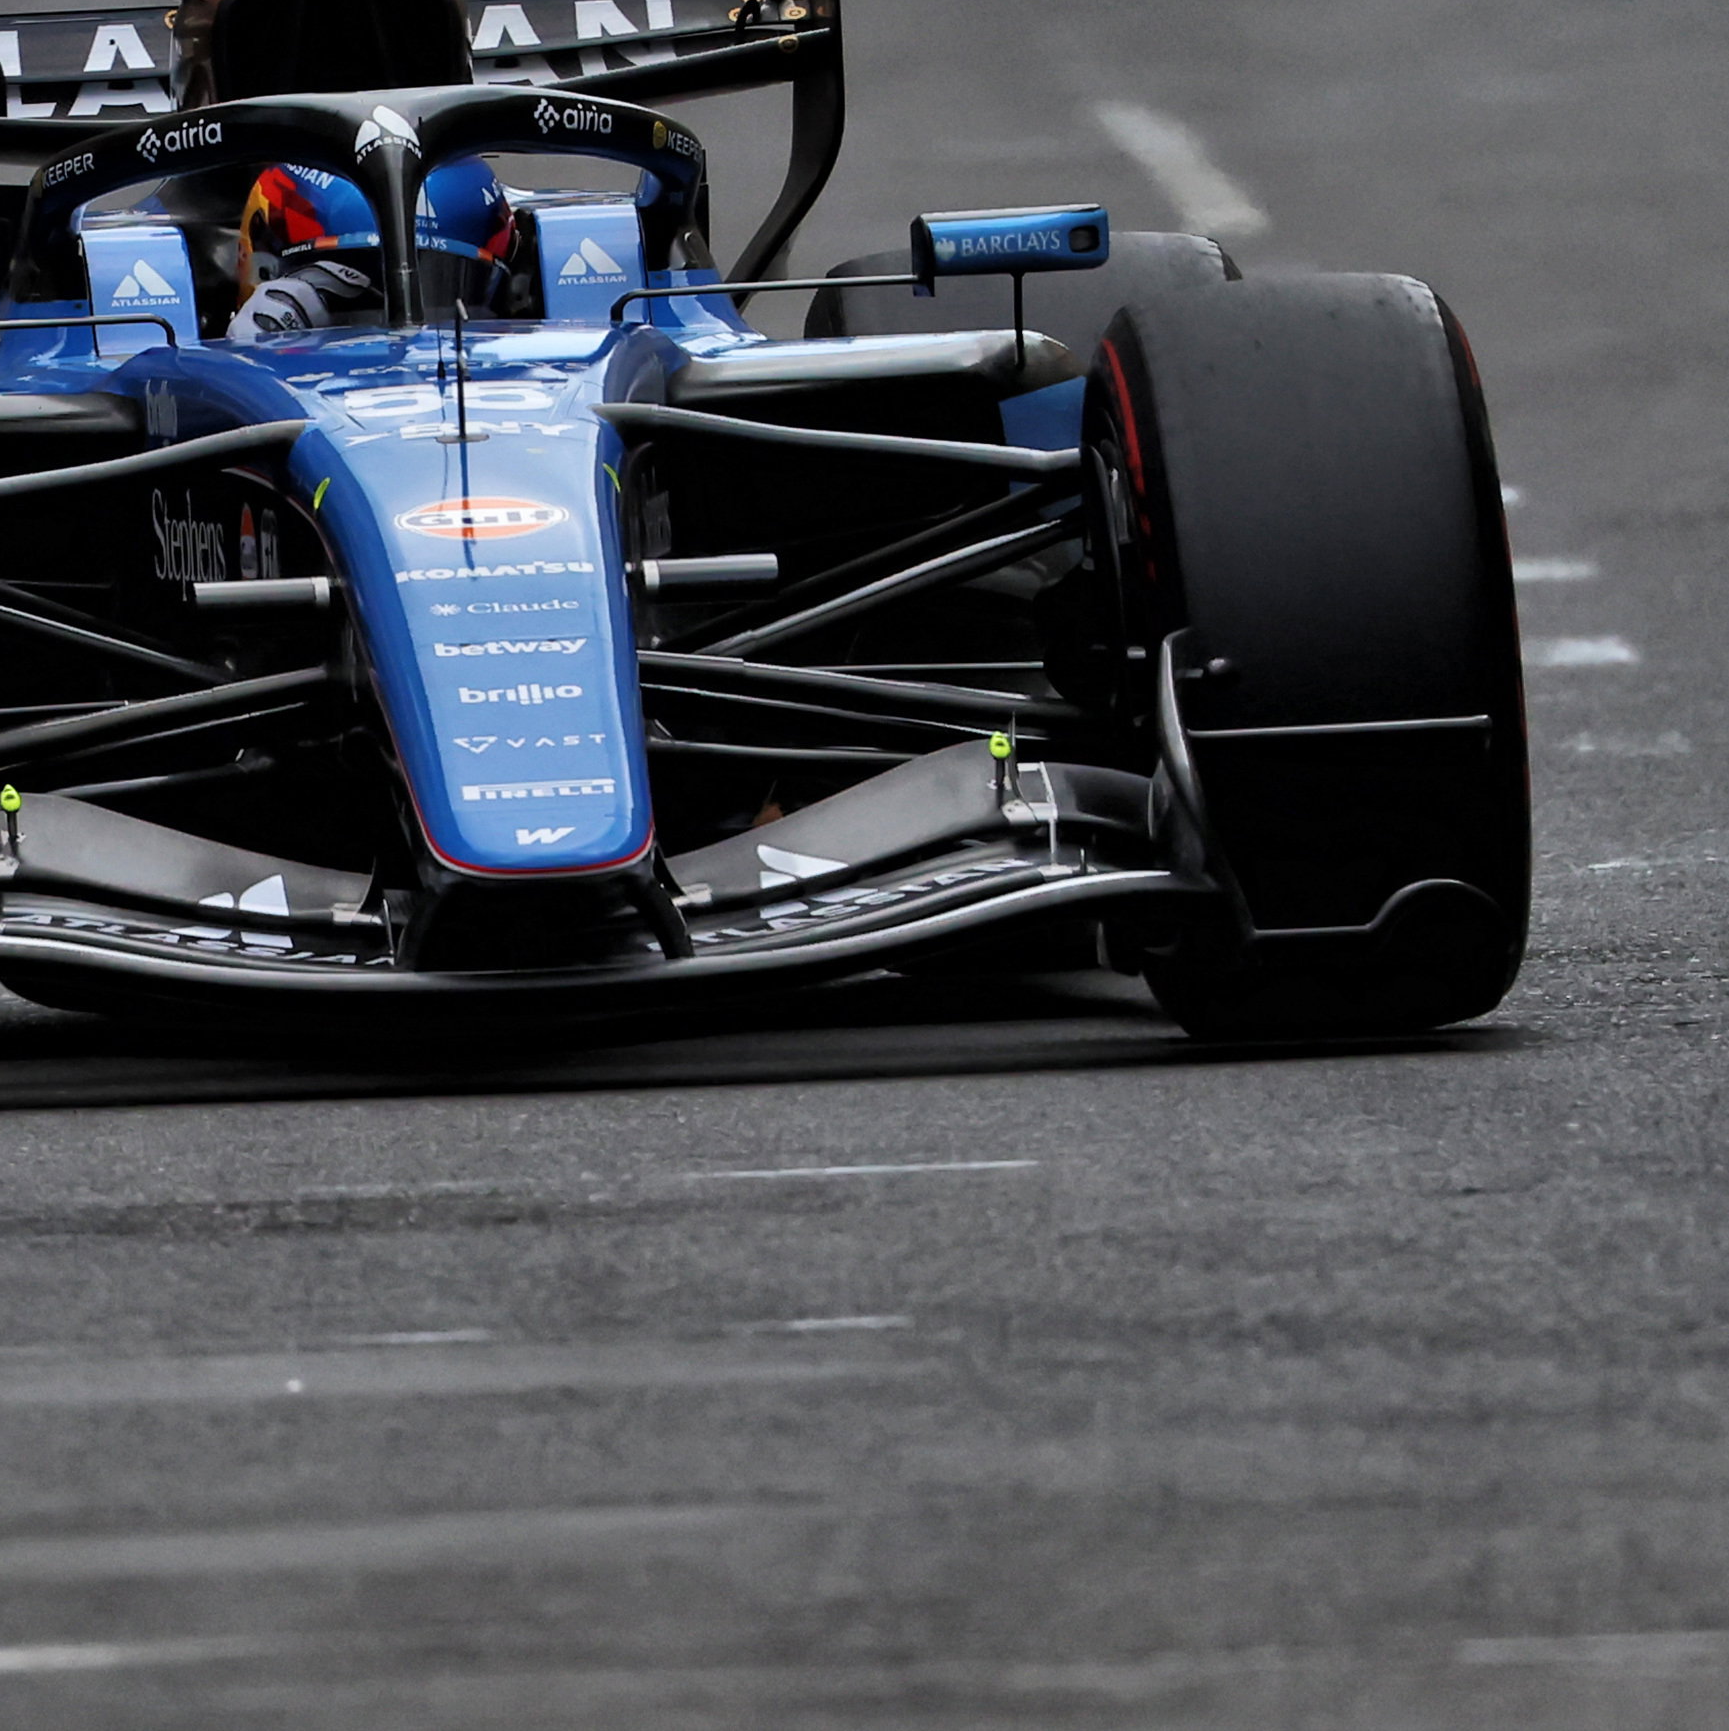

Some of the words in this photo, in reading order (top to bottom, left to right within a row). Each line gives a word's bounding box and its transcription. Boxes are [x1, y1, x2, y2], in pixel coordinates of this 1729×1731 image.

[563, 103, 613, 134] airia
[164, 118, 222, 152] airia
[355, 135, 422, 166] ATLASSIAN
[41, 152, 95, 190] KEEPER
[960, 229, 1062, 257] BARCLAYS
[557, 274, 628, 286] ATLASSIAN
[110, 296, 181, 308] ATLASSIAN
[151, 487, 227, 603] Stephens
[394, 560, 595, 584] KOMATSU
[466, 598, 580, 615] Claude
[433, 637, 588, 658] betway
[458, 683, 584, 706] brillio
[506, 733, 607, 749] VAST
[461, 778, 616, 801] PIRELLI
